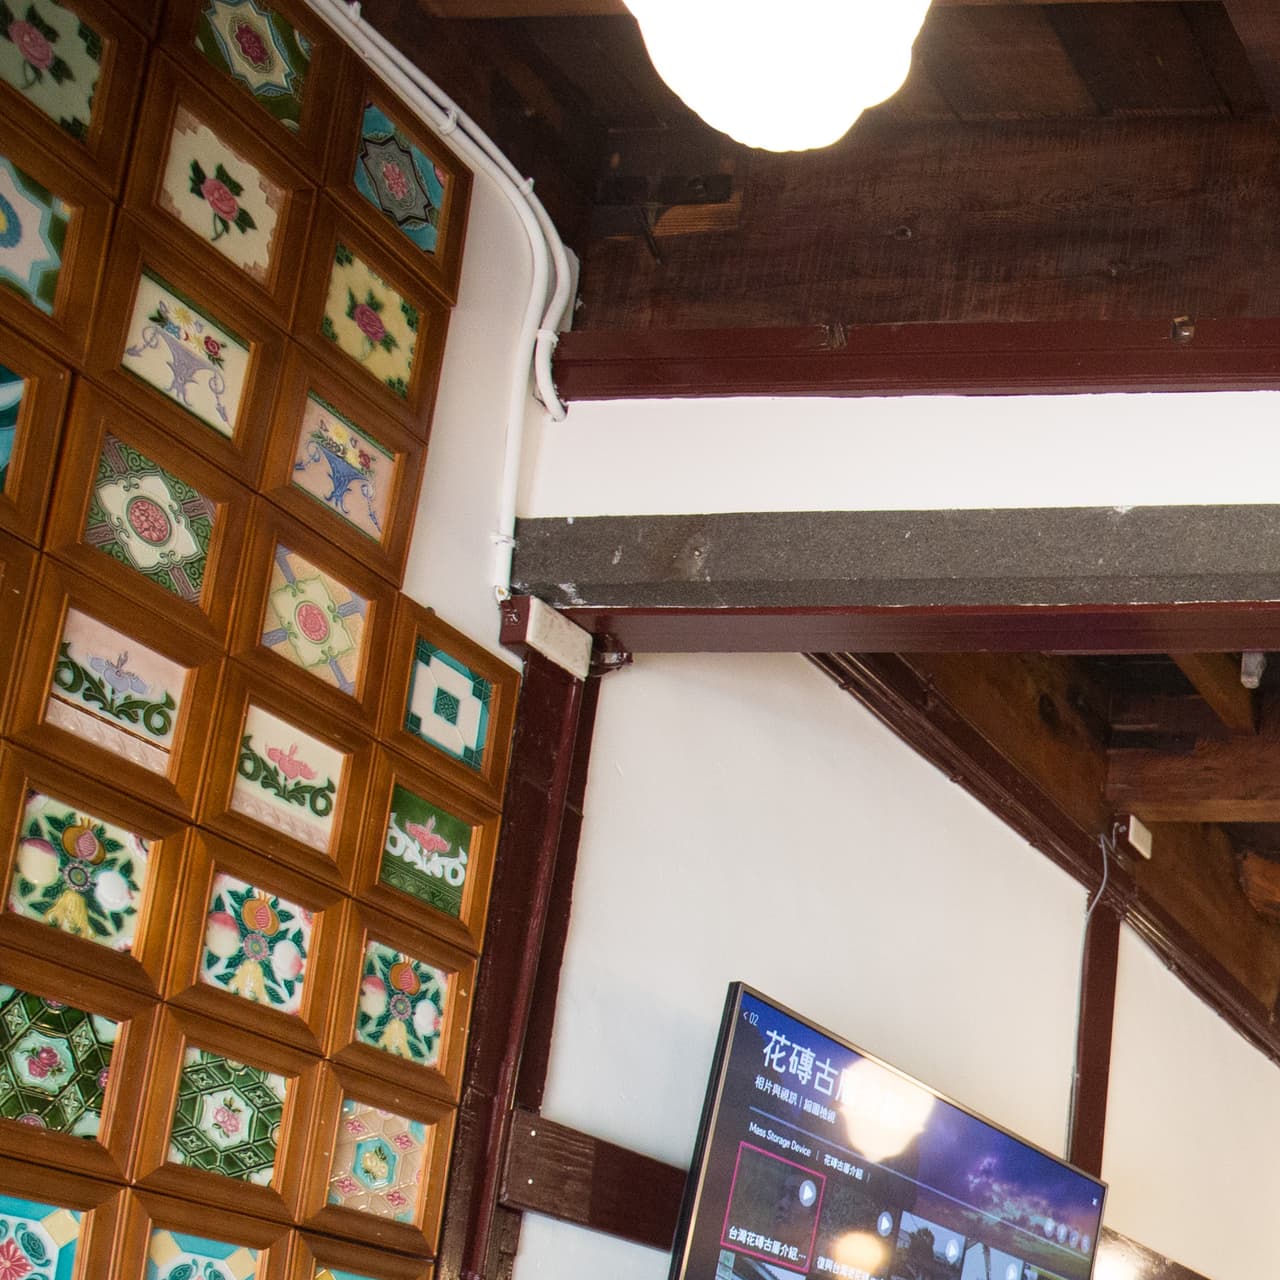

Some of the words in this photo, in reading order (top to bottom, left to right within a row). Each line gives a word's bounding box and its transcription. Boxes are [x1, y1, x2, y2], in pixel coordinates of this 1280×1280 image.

[749, 1121, 767, 1139] Mass
[766, 1128, 792, 1150] Storage
[791, 1139, 813, 1157] Device
